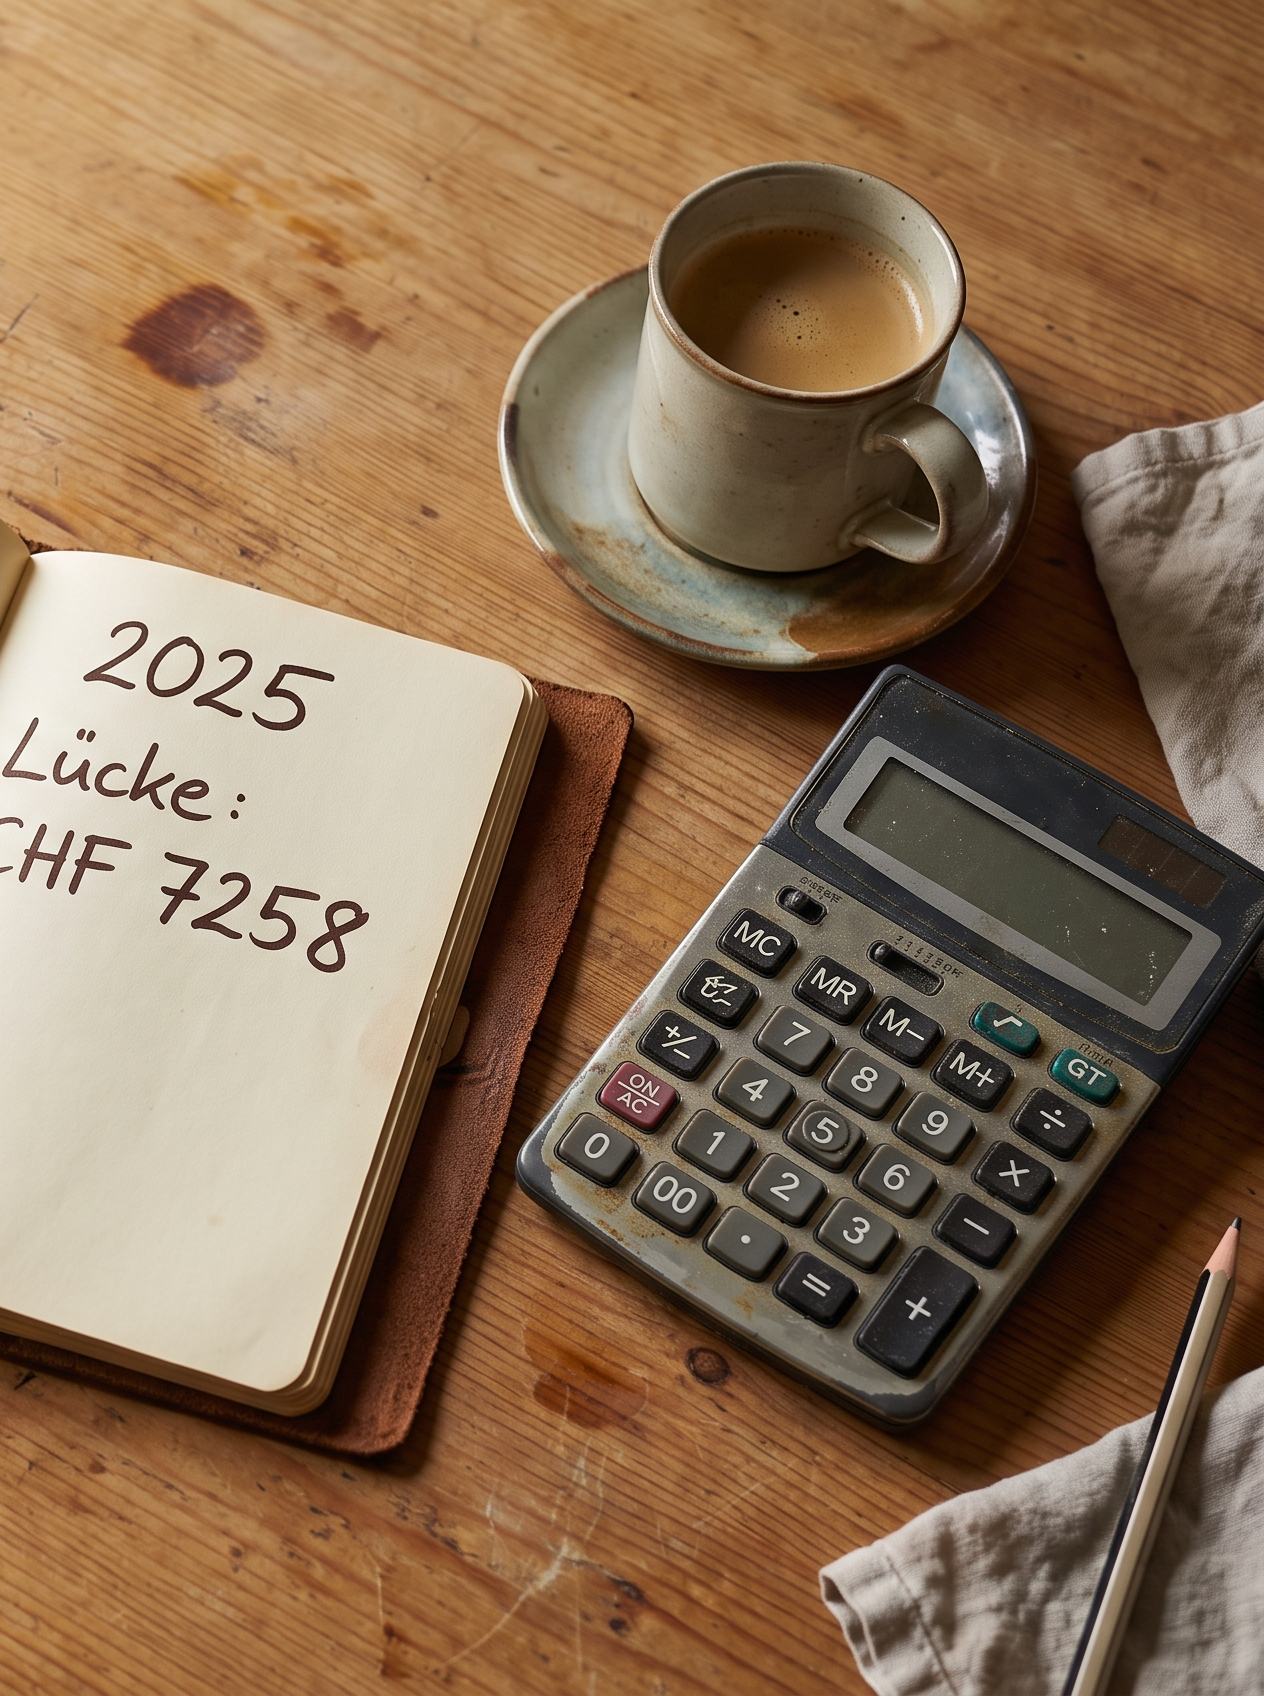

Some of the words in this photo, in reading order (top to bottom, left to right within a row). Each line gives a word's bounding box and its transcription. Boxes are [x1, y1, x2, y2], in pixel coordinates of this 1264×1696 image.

[82, 620, 336, 732] 2025
[1, 717, 246, 822] Lücke:
[159, 851, 370, 974] 7258
[733, 920, 781, 957] MC
[810, 967, 858, 1006] MR
[783, 1021, 812, 1046] 7
[850, 1066, 879, 1093] 8
[949, 1051, 995, 1088] M+
[1067, 1058, 1107, 1086] GT
[628, 1073, 661, 1097] ON
[741, 1078, 769, 1102] 4
[616, 1091, 648, 1114] AC
[810, 1116, 840, 1144] 5
[921, 1110, 949, 1136] 9
[584, 1132, 610, 1159] 0
[706, 1131, 726, 1155] 1
[769, 1172, 800, 1202] 2
[883, 1163, 911, 1191] 6
[653, 1175, 697, 1214] 00
[842, 1216, 871, 1244] 3
